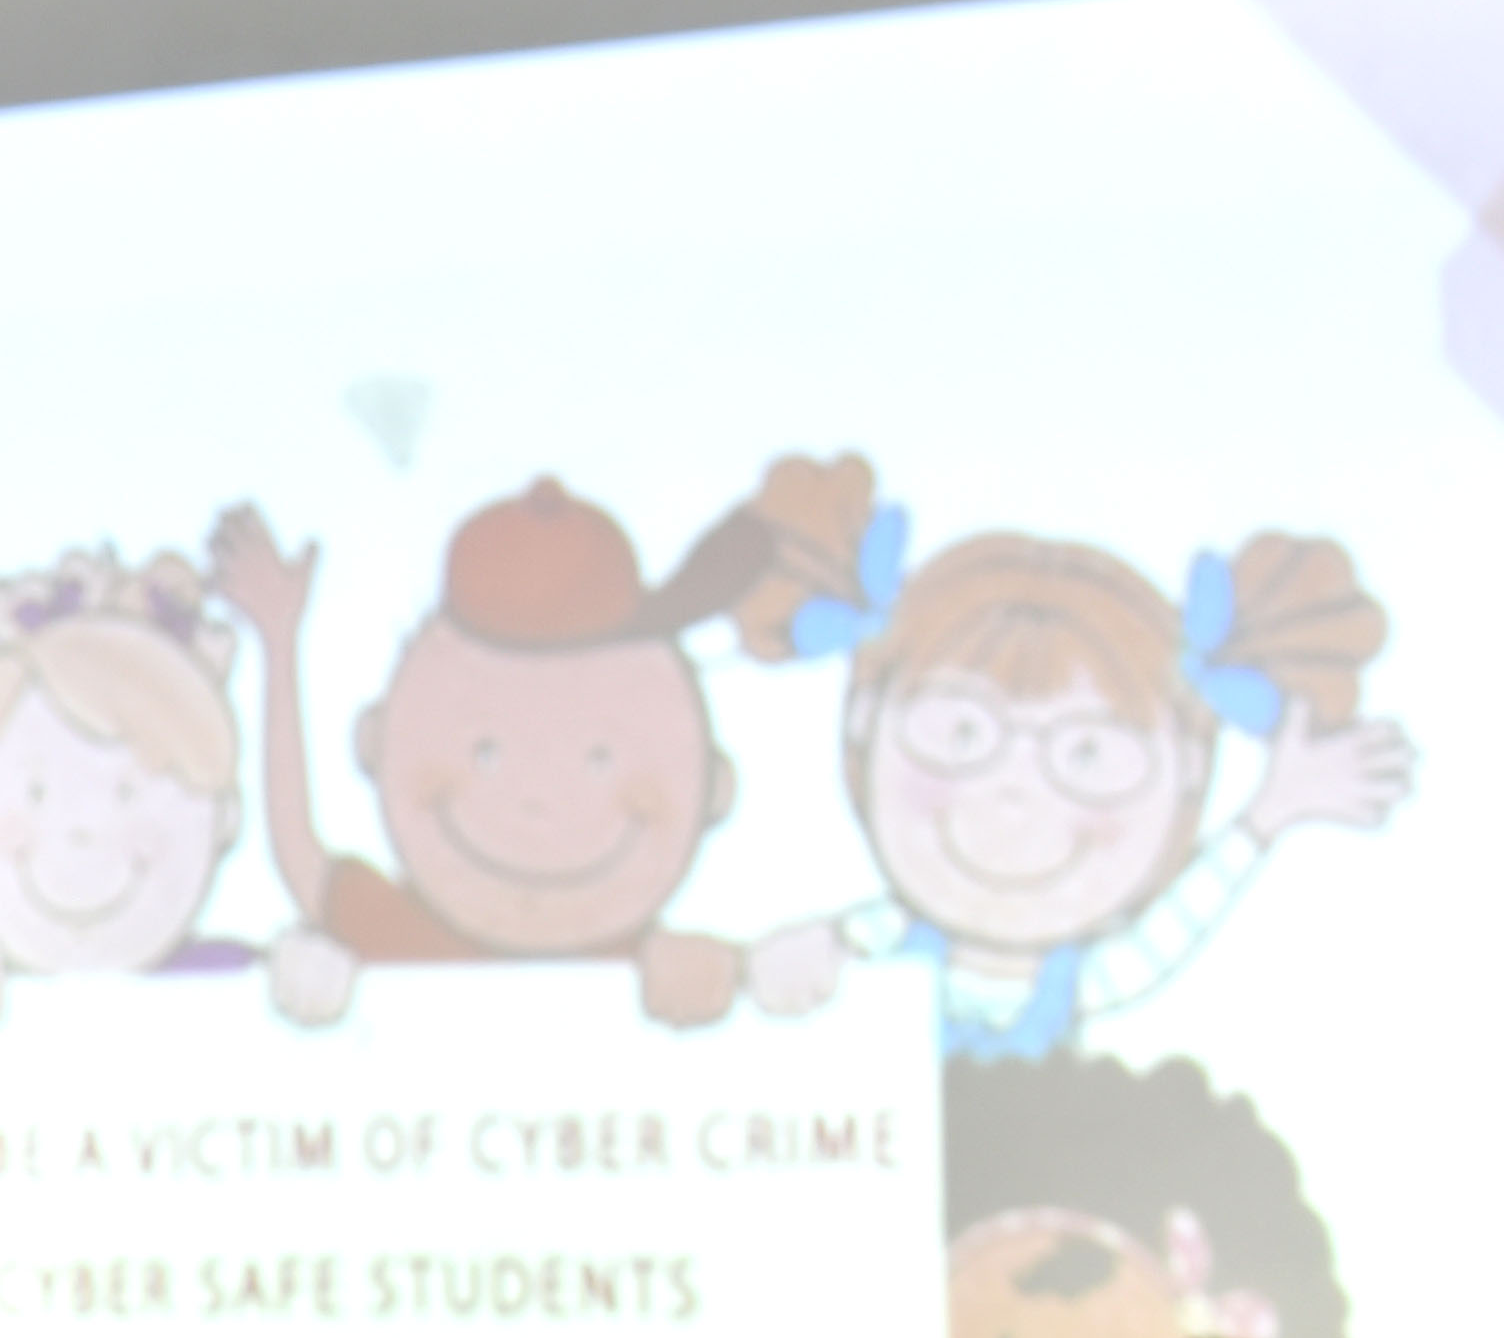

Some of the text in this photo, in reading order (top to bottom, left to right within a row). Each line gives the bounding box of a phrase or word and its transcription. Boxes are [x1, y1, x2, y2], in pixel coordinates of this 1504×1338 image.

[72, 1122, 114, 1184] A
[129, 1111, 346, 1186] VICTIM
[361, 1111, 445, 1183] OF
[467, 1107, 675, 1182] CYBER
[693, 1104, 904, 1178] CRIME
[196, 1253, 348, 1324] SAFE
[364, 1252, 706, 1328] STUDENTS
